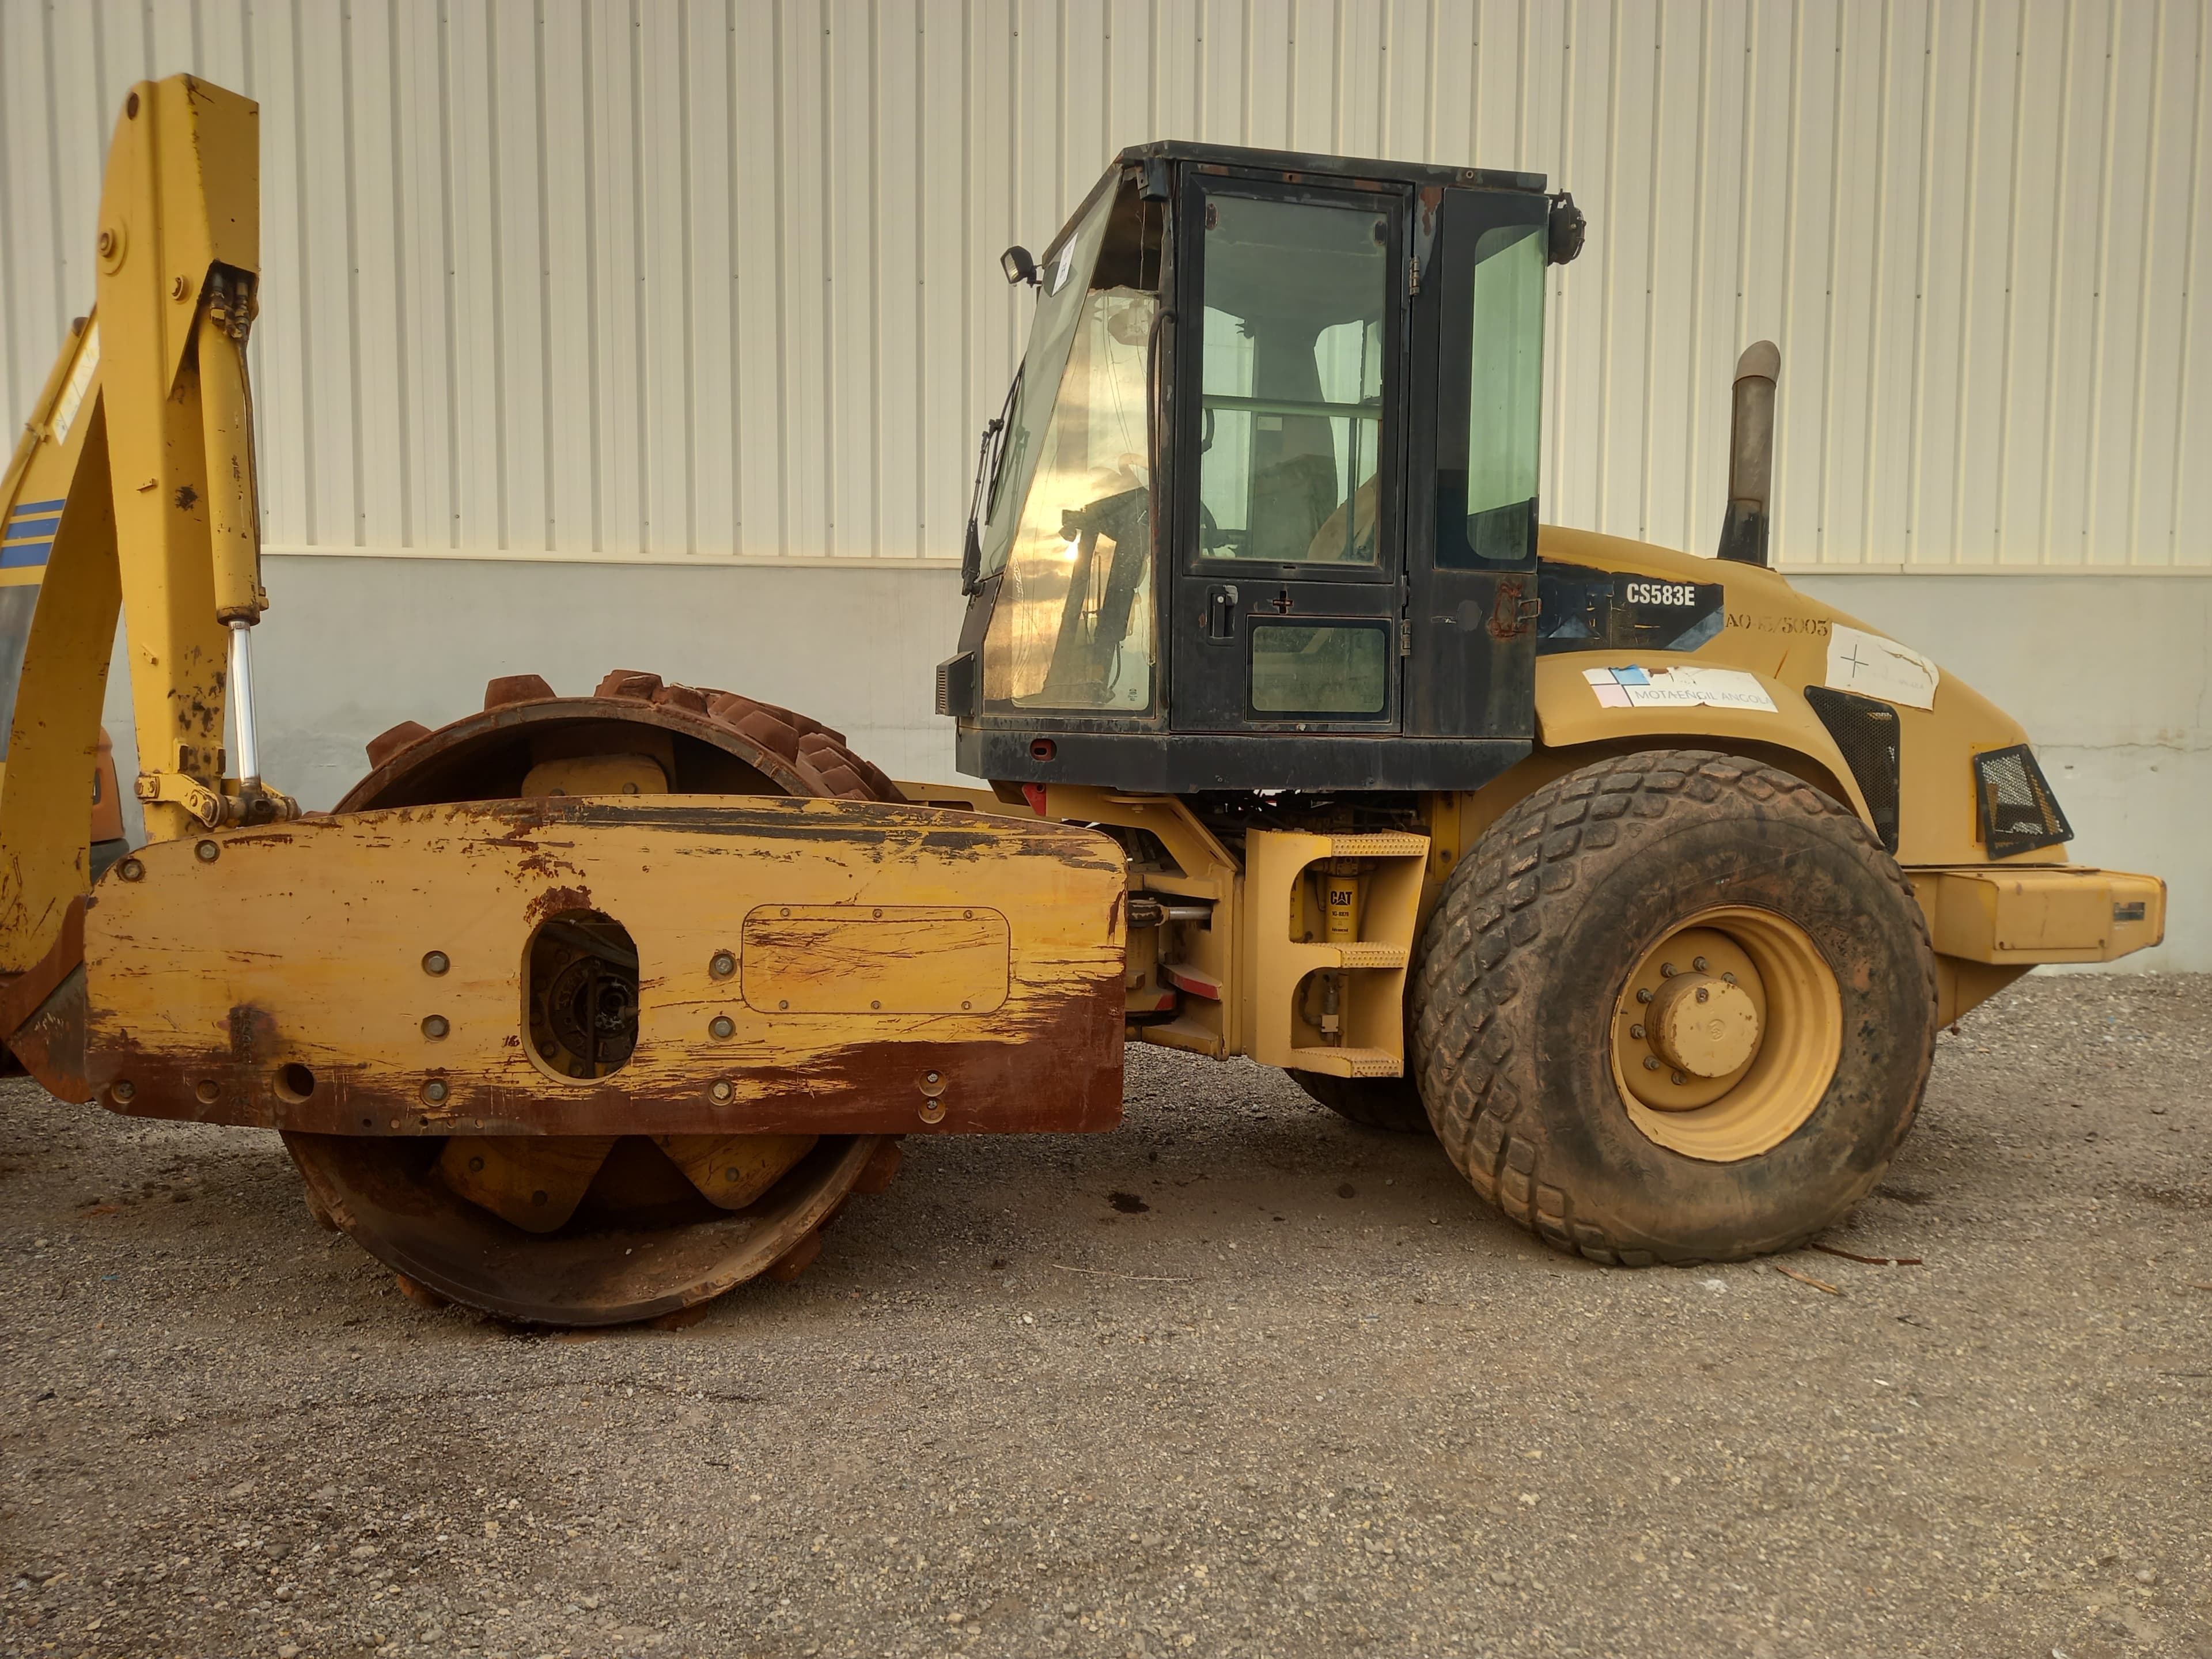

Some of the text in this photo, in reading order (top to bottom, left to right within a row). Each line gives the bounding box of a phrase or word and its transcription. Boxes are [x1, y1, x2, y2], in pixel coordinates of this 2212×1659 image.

[1626, 583, 1696, 607] CS583E
[1721, 691, 1772, 705] ANGOLA
[1330, 891, 1353, 906] CAT
